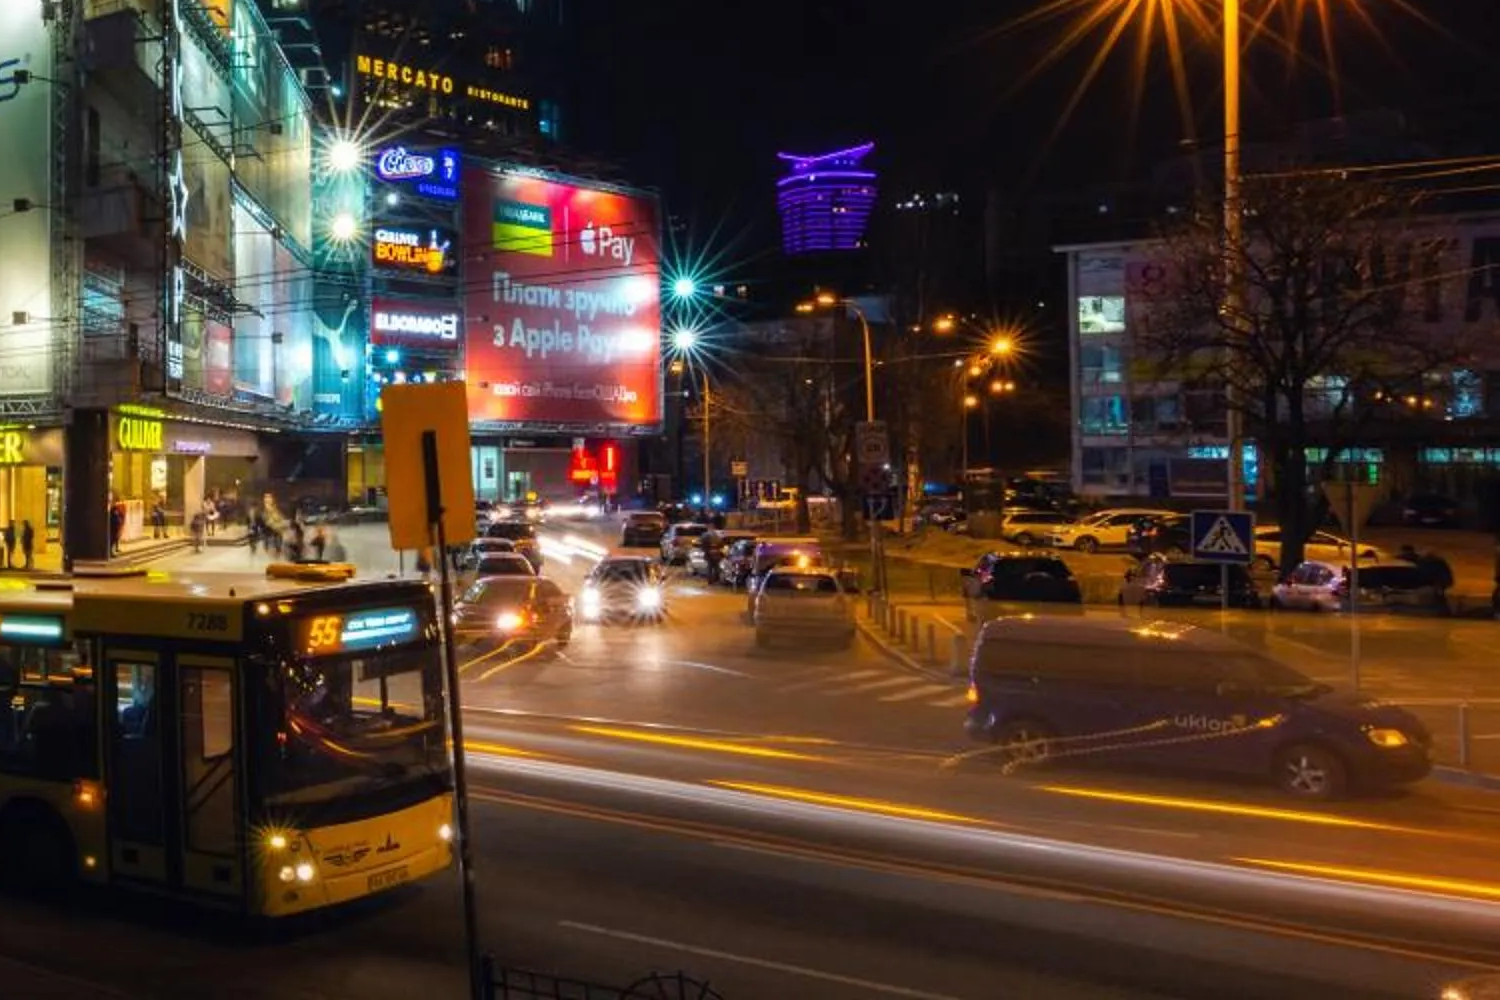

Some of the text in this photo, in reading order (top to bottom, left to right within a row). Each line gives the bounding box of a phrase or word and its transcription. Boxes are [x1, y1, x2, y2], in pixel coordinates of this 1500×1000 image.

[357, 55, 453, 93] MERCATO
[599, 226, 635, 266] Pay
[492, 270, 561, 309] Плати
[509, 317, 576, 358] Apple
[119, 417, 162, 450] GULLIVER
[309, 616, 340, 647] 55
